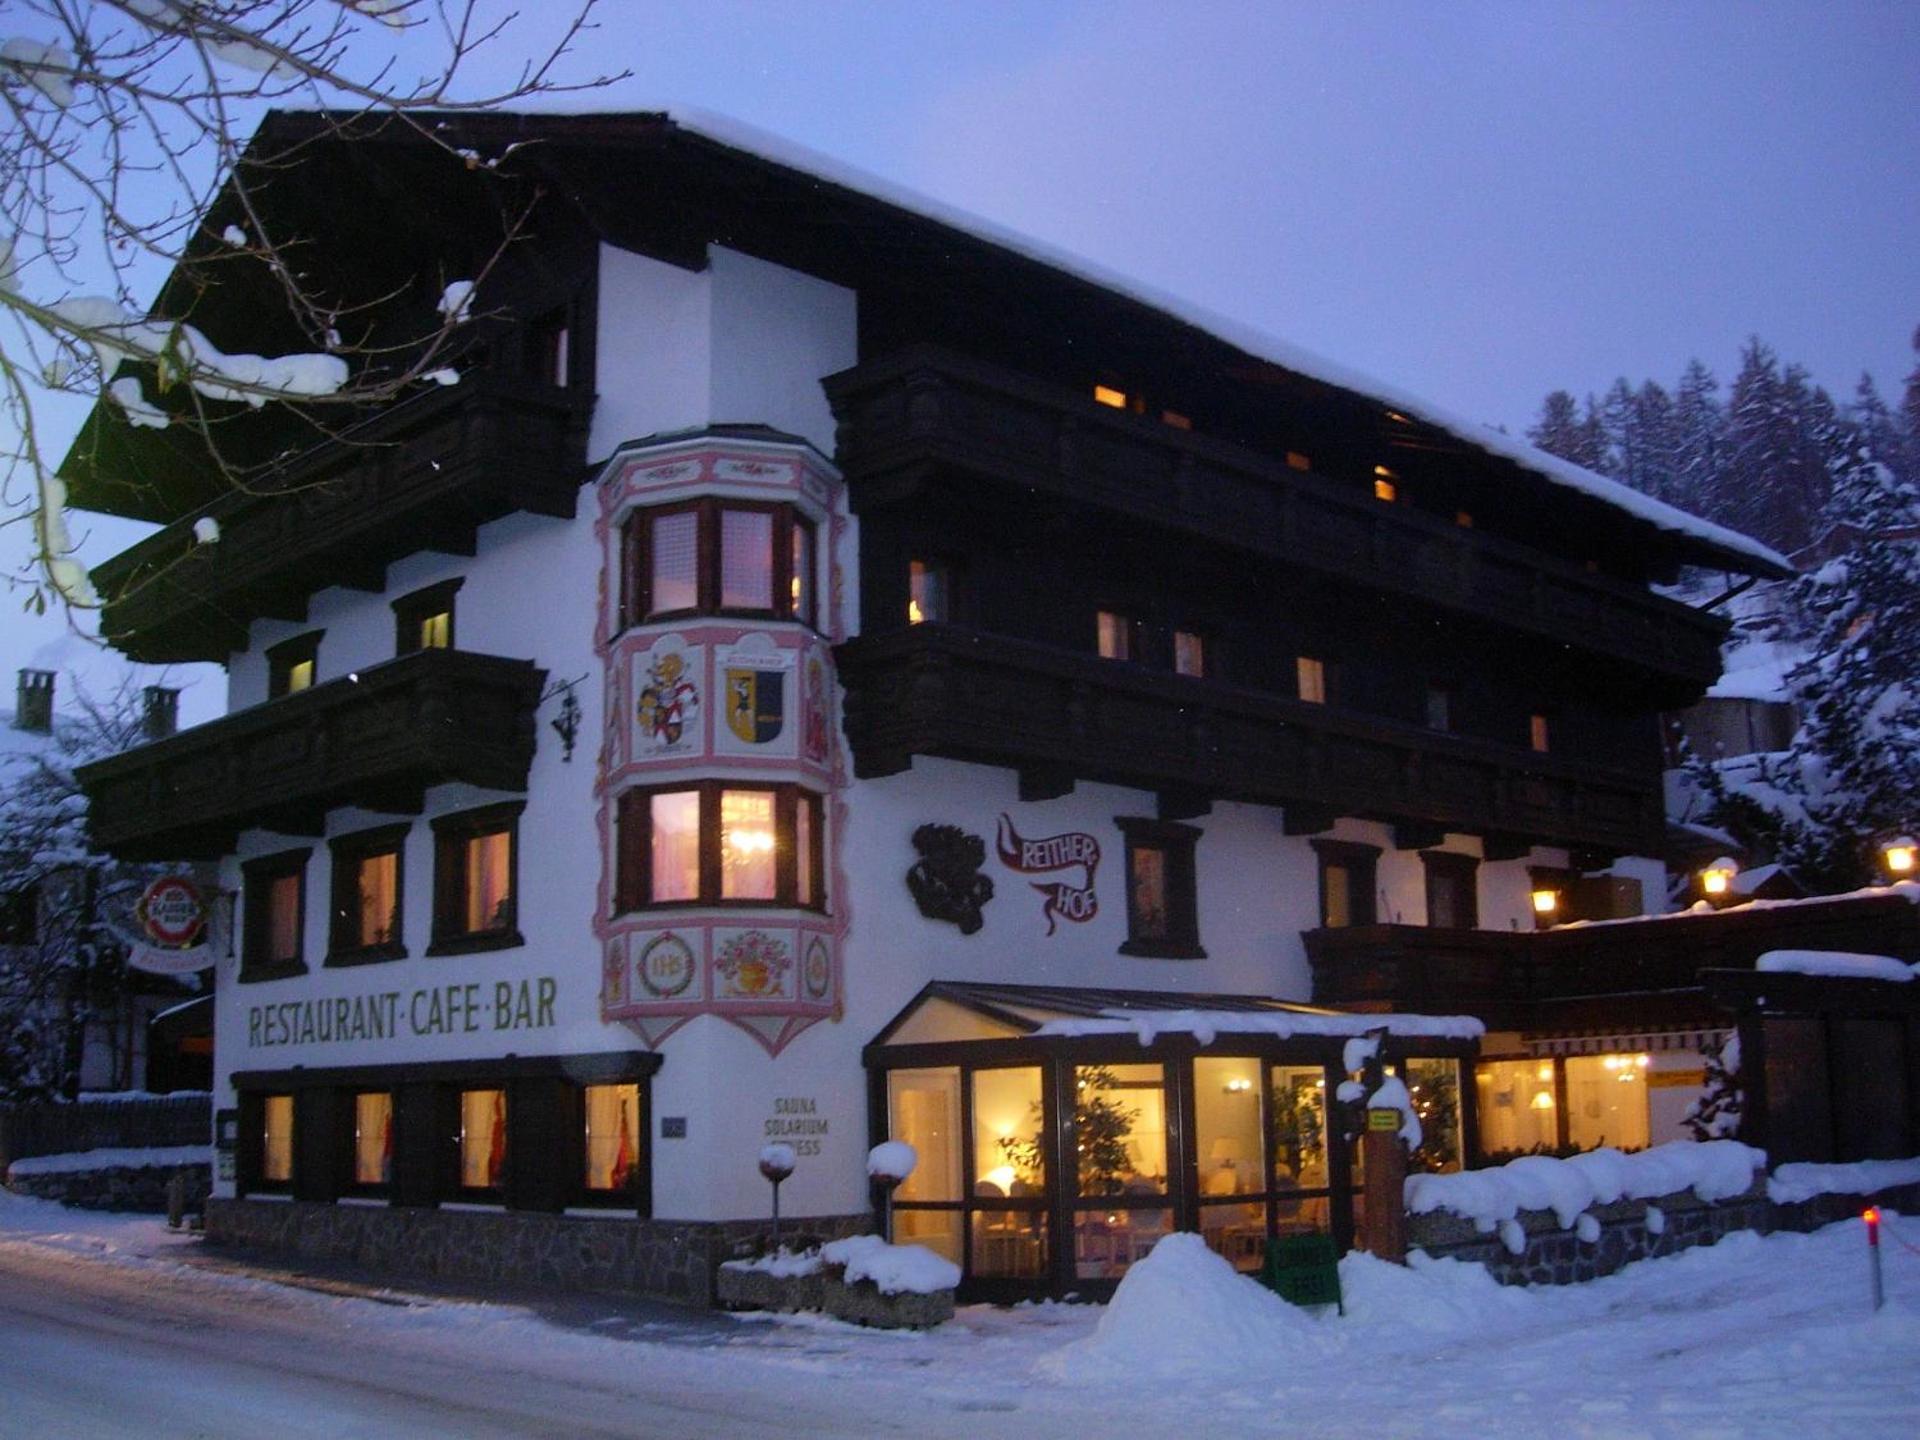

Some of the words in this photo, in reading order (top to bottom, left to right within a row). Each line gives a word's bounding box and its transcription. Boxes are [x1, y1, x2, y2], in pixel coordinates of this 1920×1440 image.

[1022, 833, 1099, 868] REITHER
[1057, 885, 1096, 917] HOF
[494, 977, 557, 1031] BAR
[774, 1097, 816, 1115] SAUNA
[764, 1118, 829, 1136] SOLARIUM
